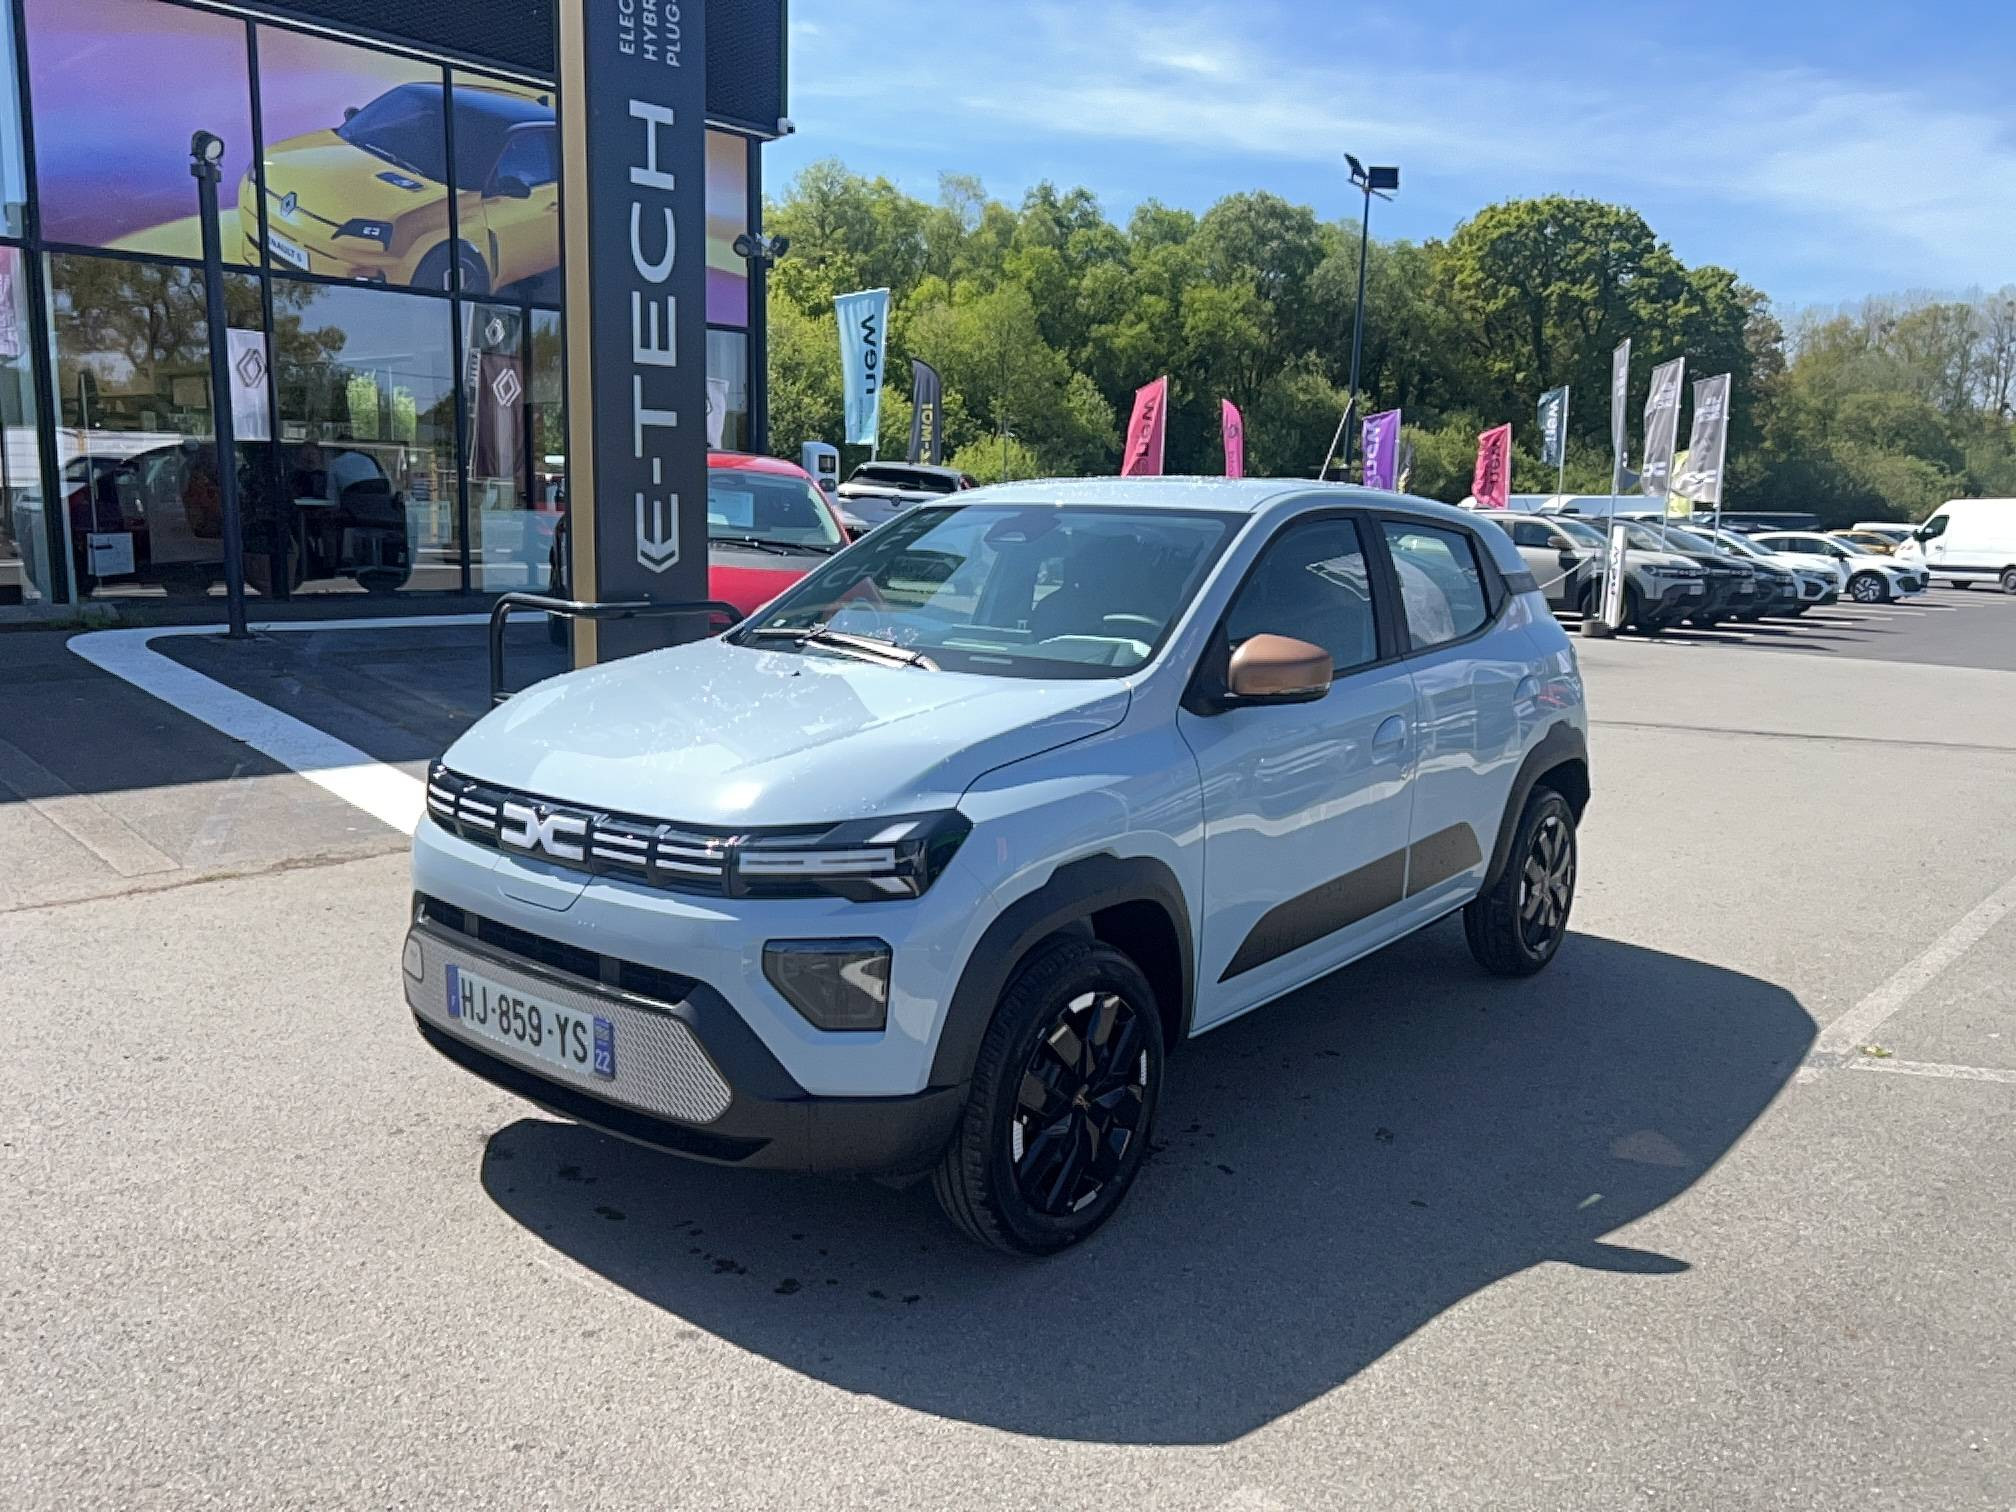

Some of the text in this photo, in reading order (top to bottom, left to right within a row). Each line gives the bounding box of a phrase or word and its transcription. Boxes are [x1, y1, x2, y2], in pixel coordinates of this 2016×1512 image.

[629, 99, 680, 573] E-TECH
[461, 977, 588, 1063] HJ-859-YS
[595, 1050, 610, 1073] 22
